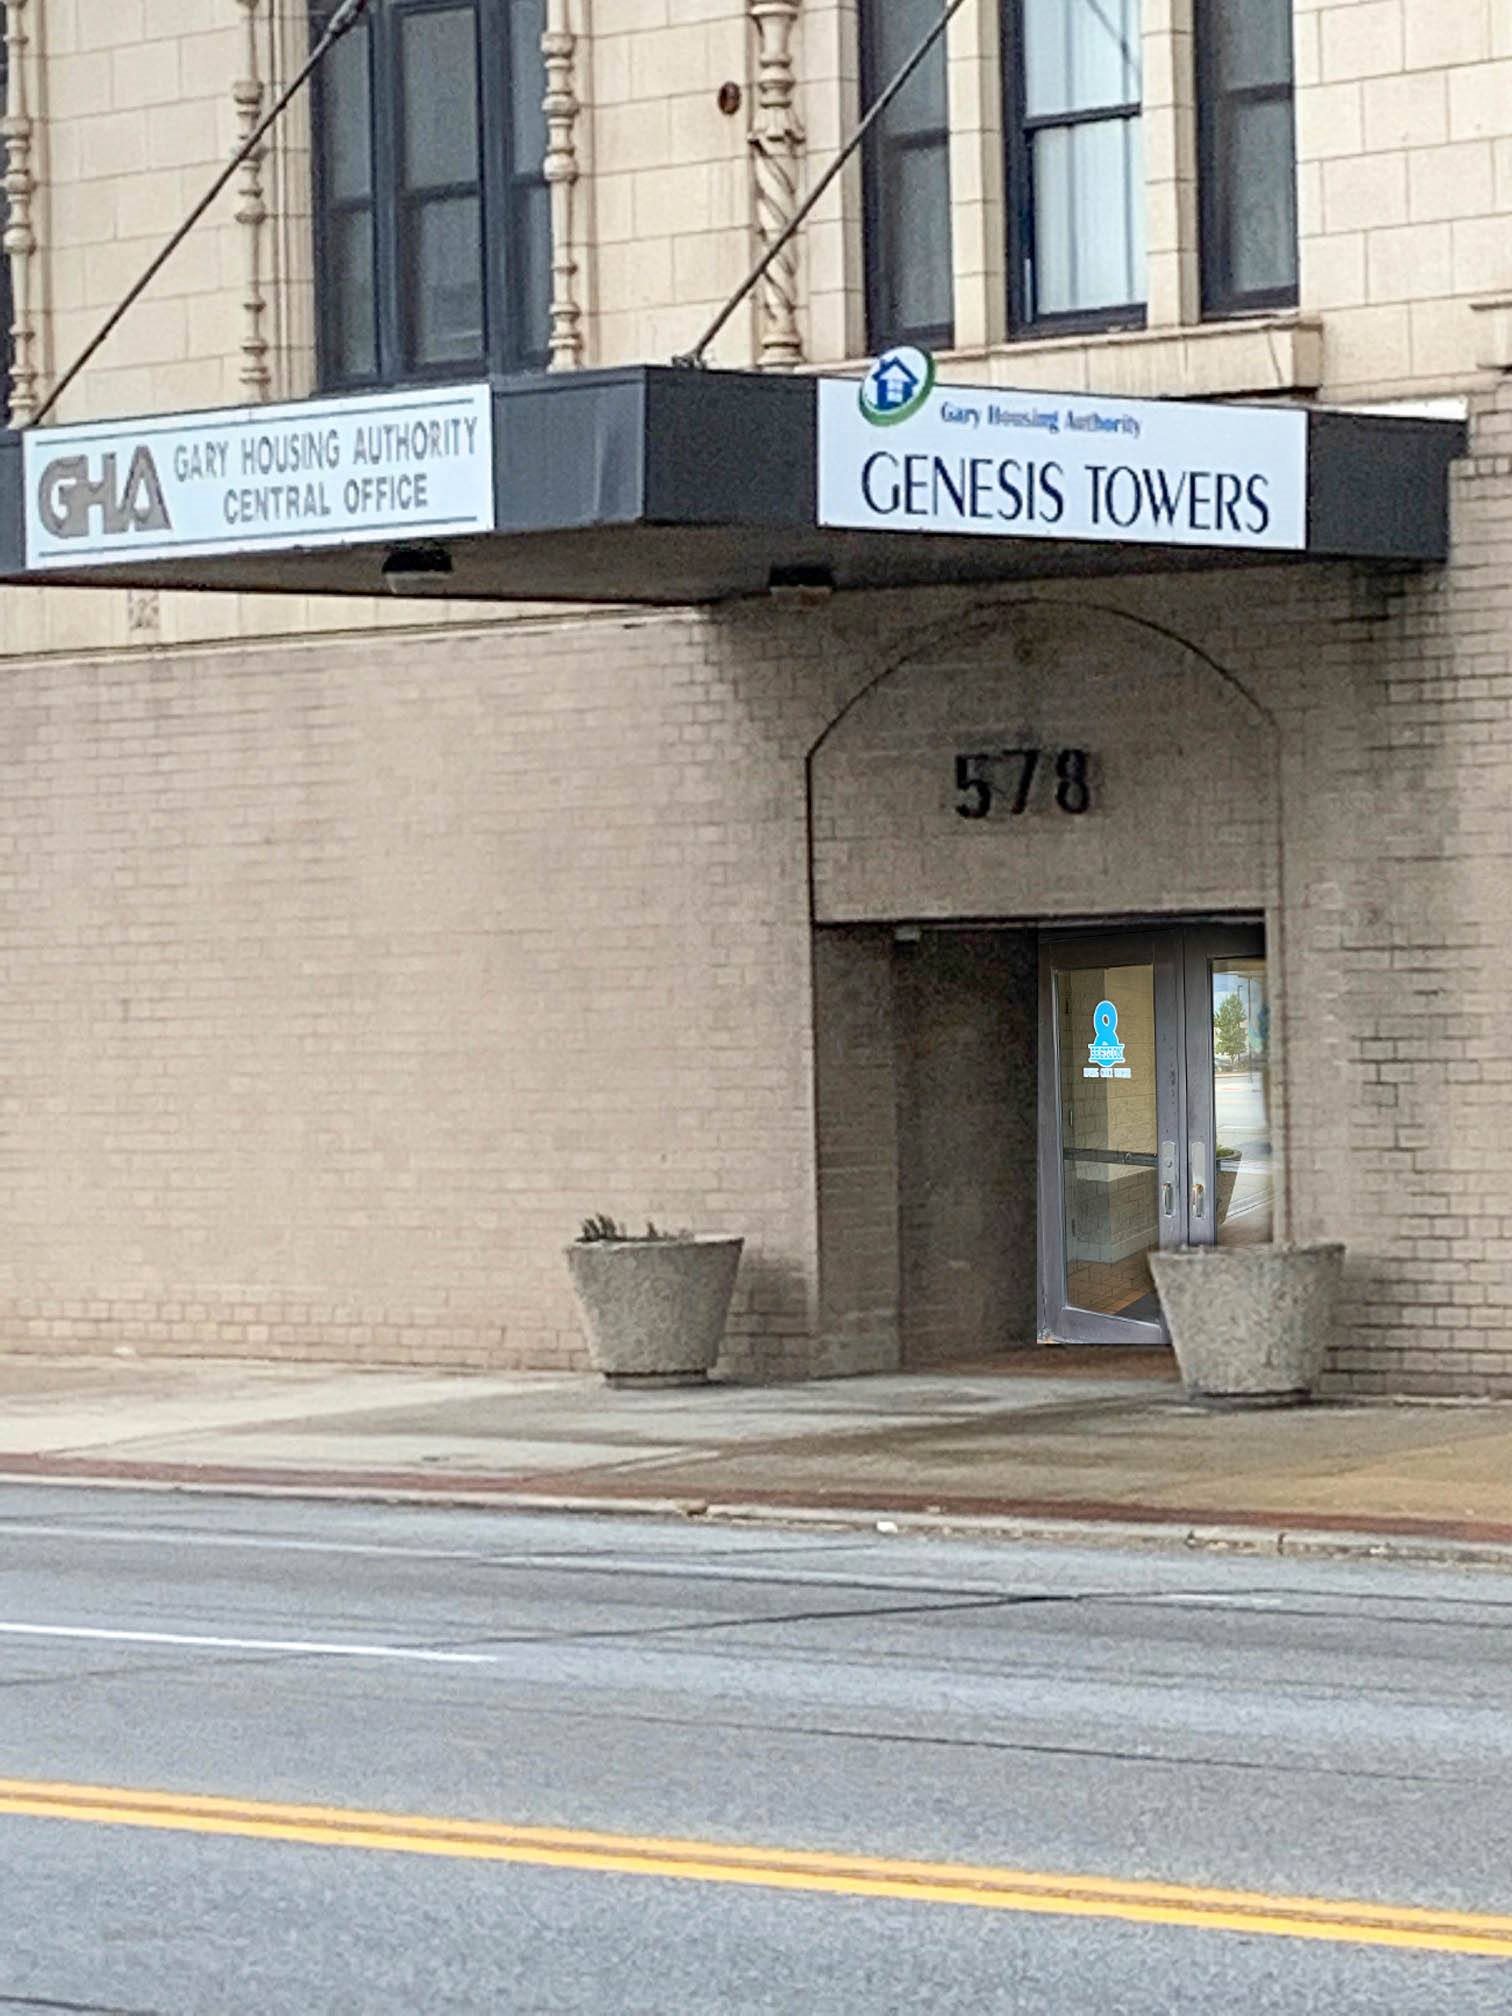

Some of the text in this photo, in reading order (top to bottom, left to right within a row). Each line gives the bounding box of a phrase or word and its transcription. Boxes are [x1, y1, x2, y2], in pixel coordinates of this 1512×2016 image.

[173, 416, 478, 483] GARY HOUSING AUTHORITY
[940, 403, 1141, 439] Gary Housing Authority
[37, 444, 173, 540] GHA
[222, 473, 429, 526] CENTRAL OFFICE
[861, 450, 1270, 534] GENESIS TOWERS
[954, 748, 1091, 819] 578
